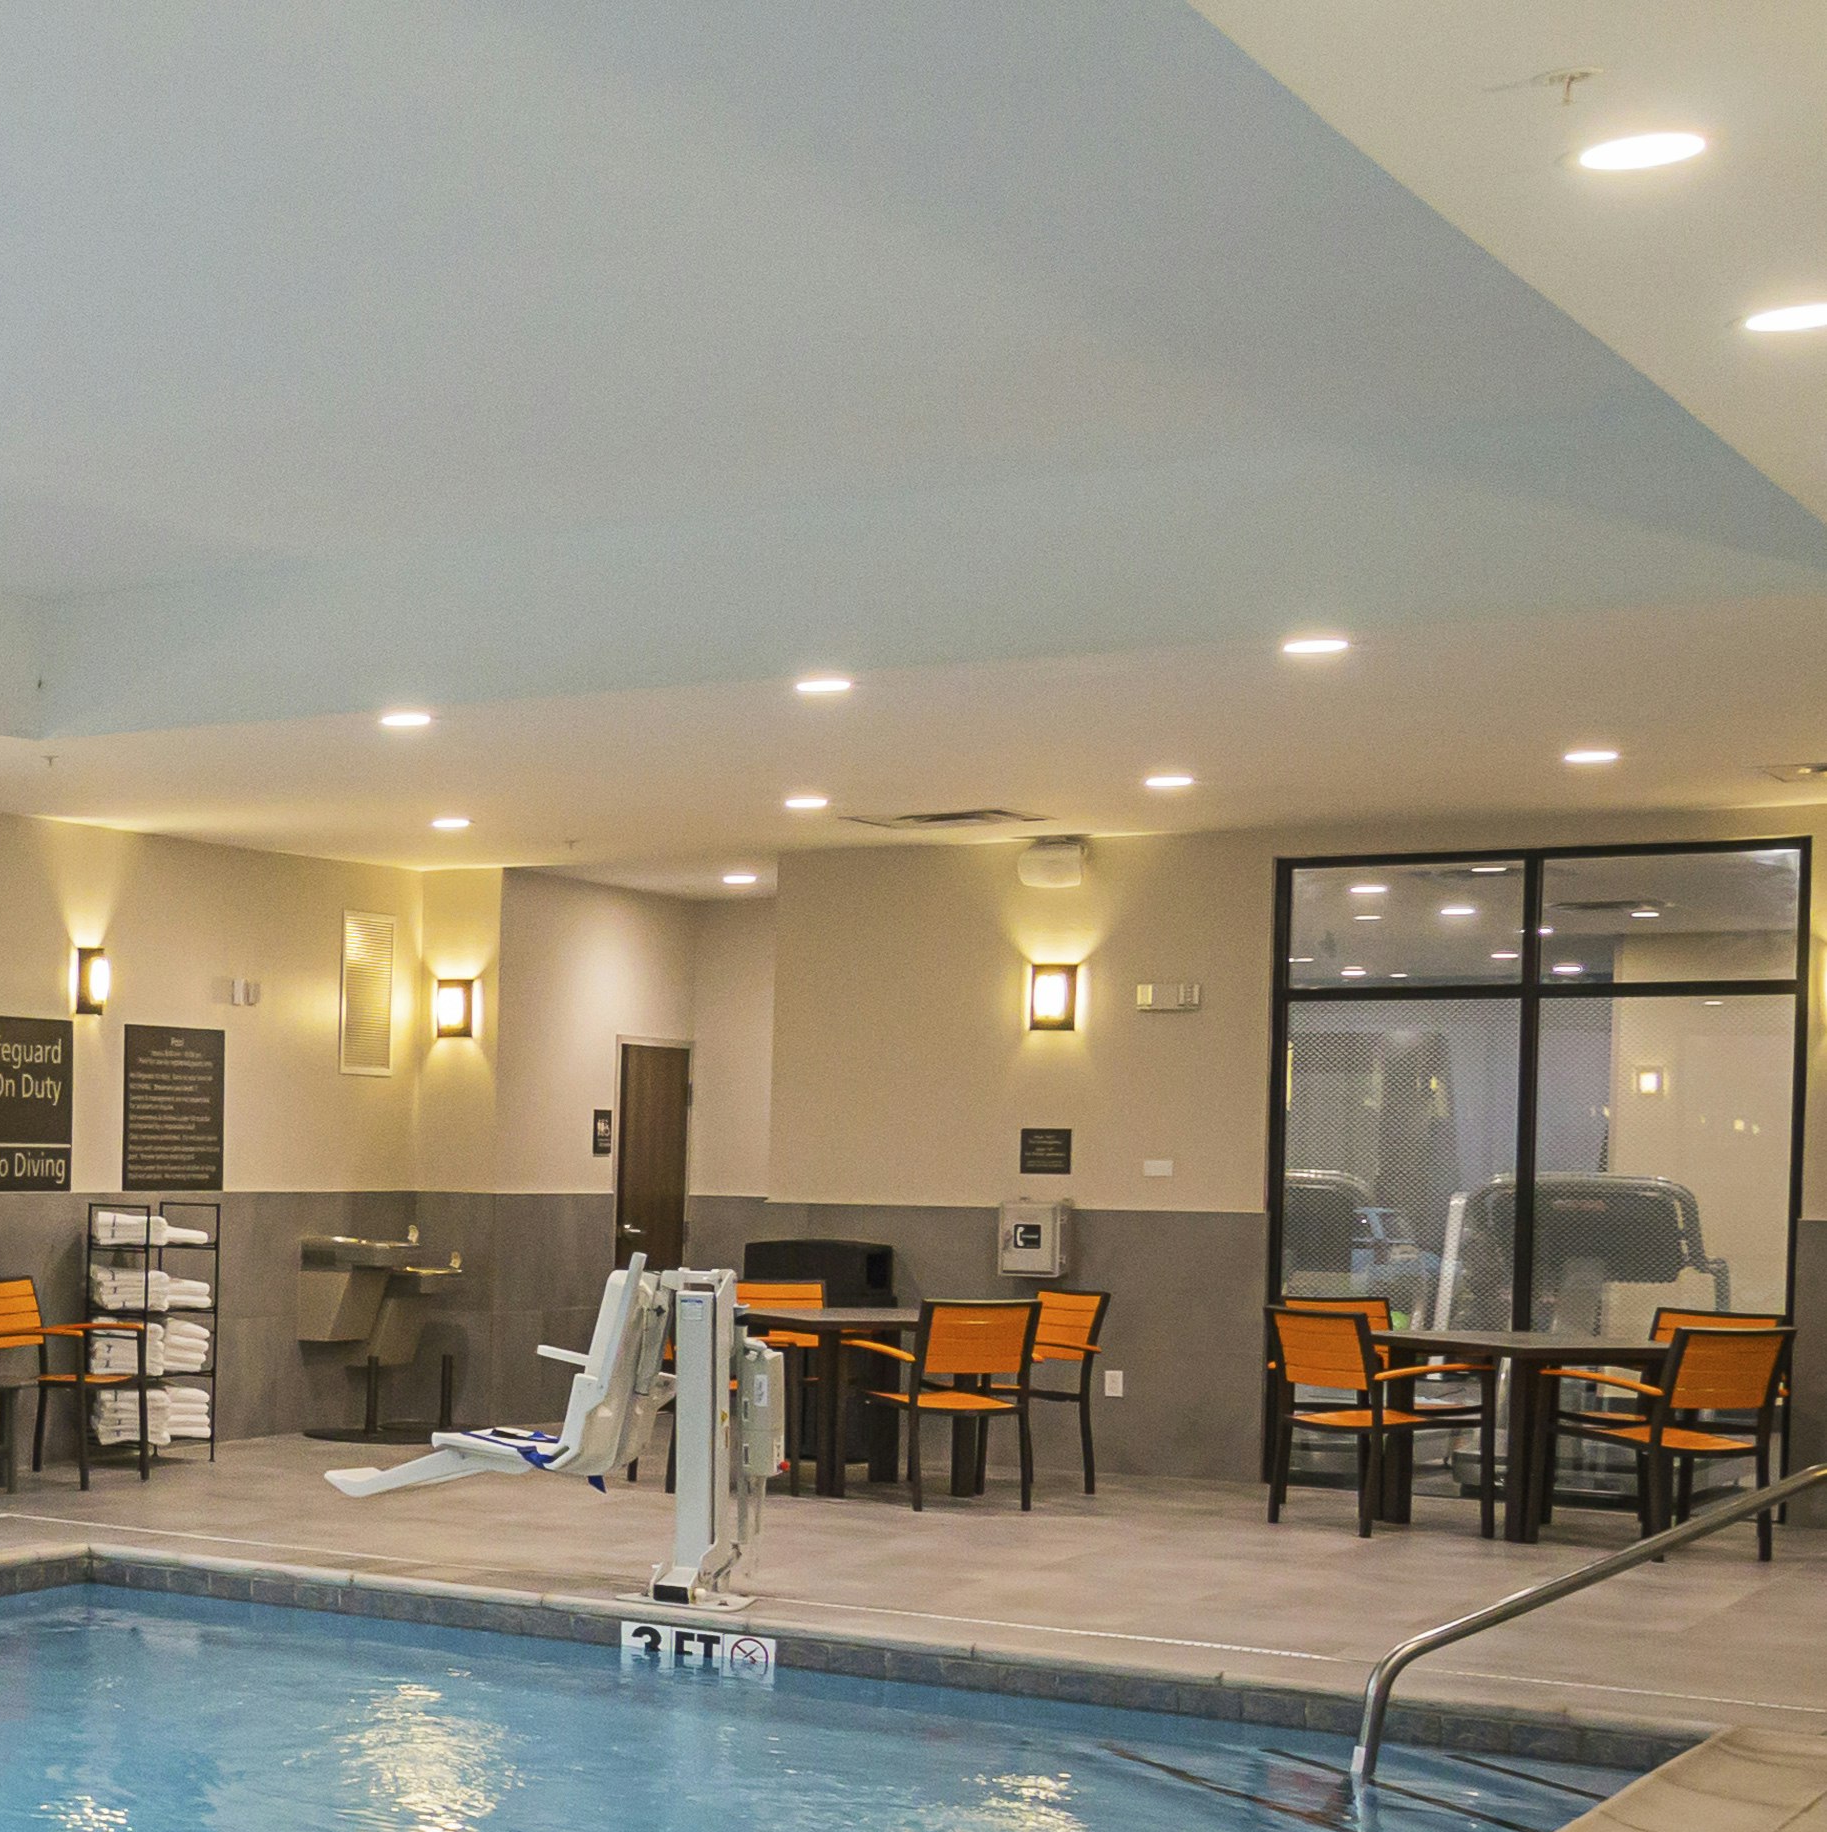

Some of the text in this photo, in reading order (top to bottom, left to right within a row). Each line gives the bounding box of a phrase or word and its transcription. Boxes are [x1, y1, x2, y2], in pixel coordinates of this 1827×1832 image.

[21, 1073, 62, 1106] Duty
[14, 1152, 66, 1184] Diving
[675, 1630, 721, 1659] FT
